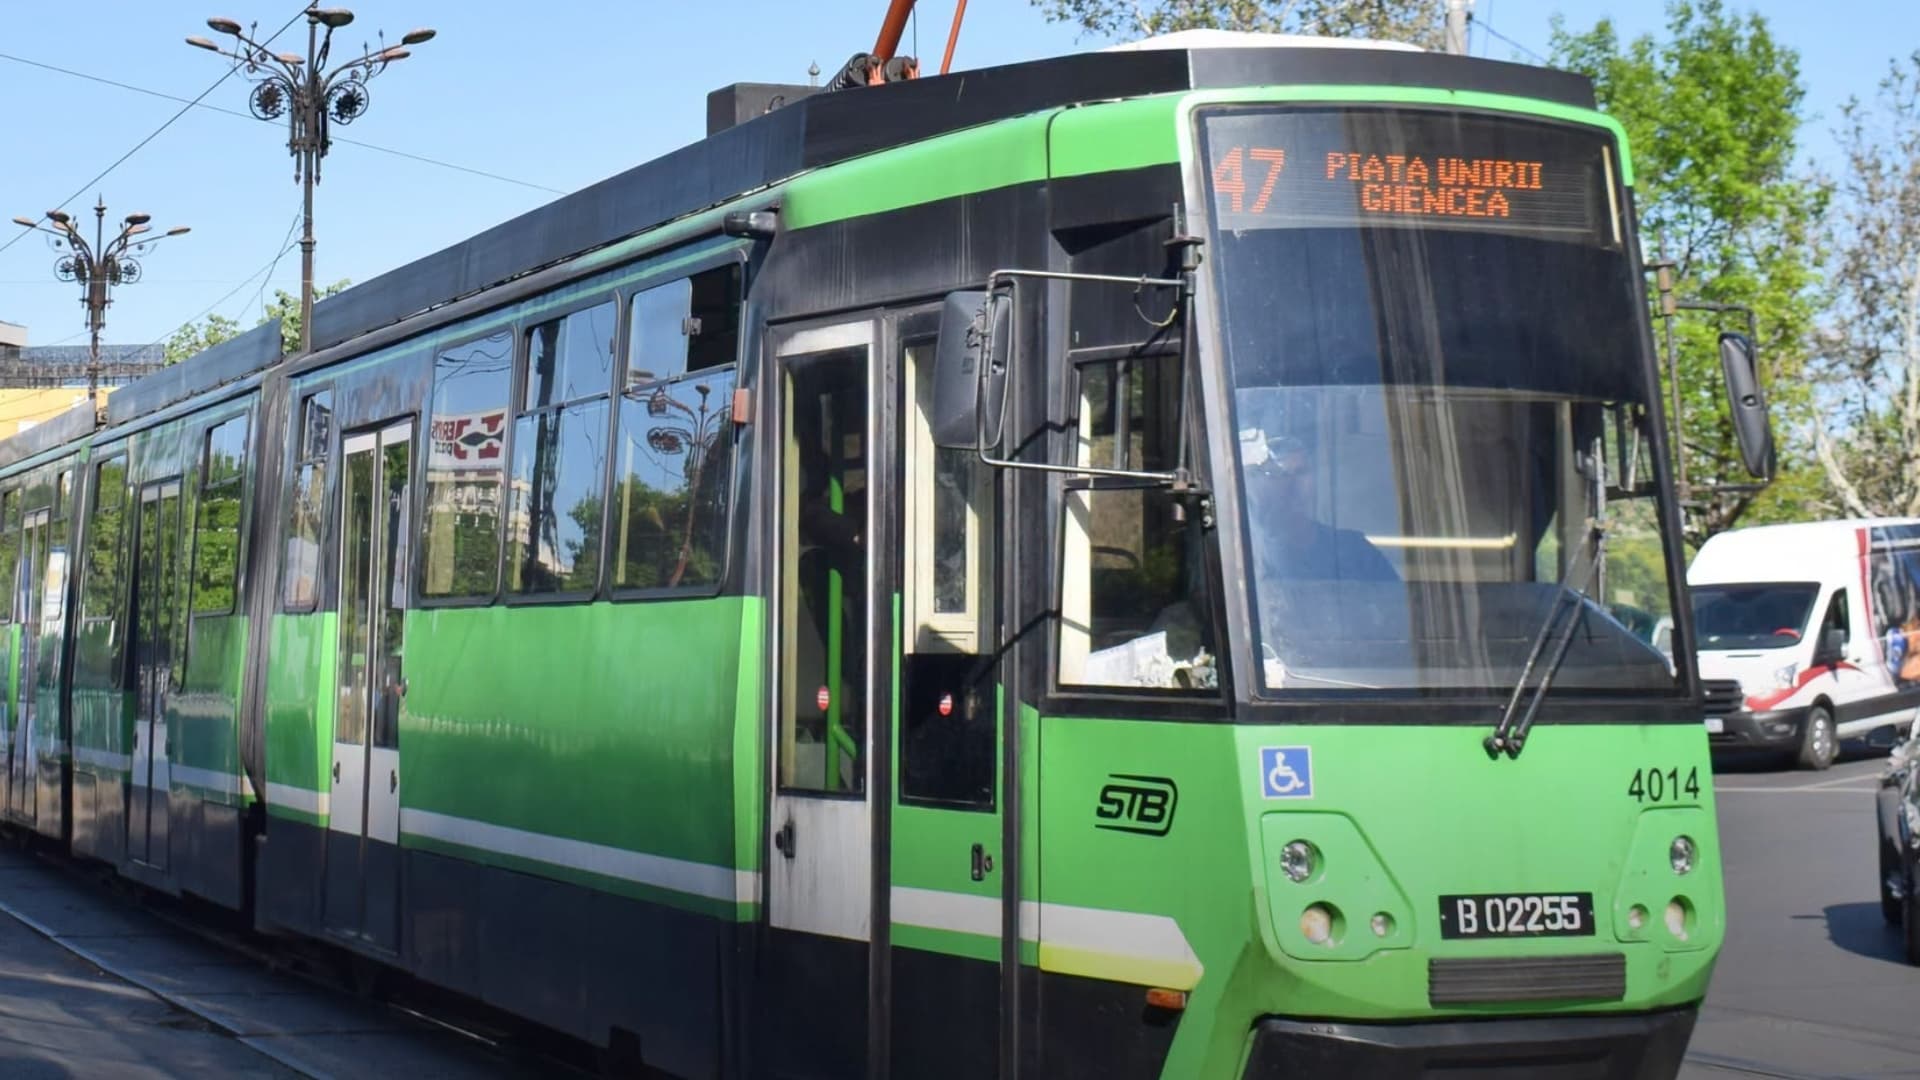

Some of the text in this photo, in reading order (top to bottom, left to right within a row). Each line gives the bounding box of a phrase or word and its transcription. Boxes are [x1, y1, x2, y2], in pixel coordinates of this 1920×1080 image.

[1213, 146, 1286, 214] 47
[1327, 152, 1544, 190] PIATA UNIRII
[1362, 185, 1510, 217] GHENCEA
[1628, 765, 1701, 803] 4014
[1096, 784, 1169, 824] STB
[1457, 895, 1582, 934] B 02255
